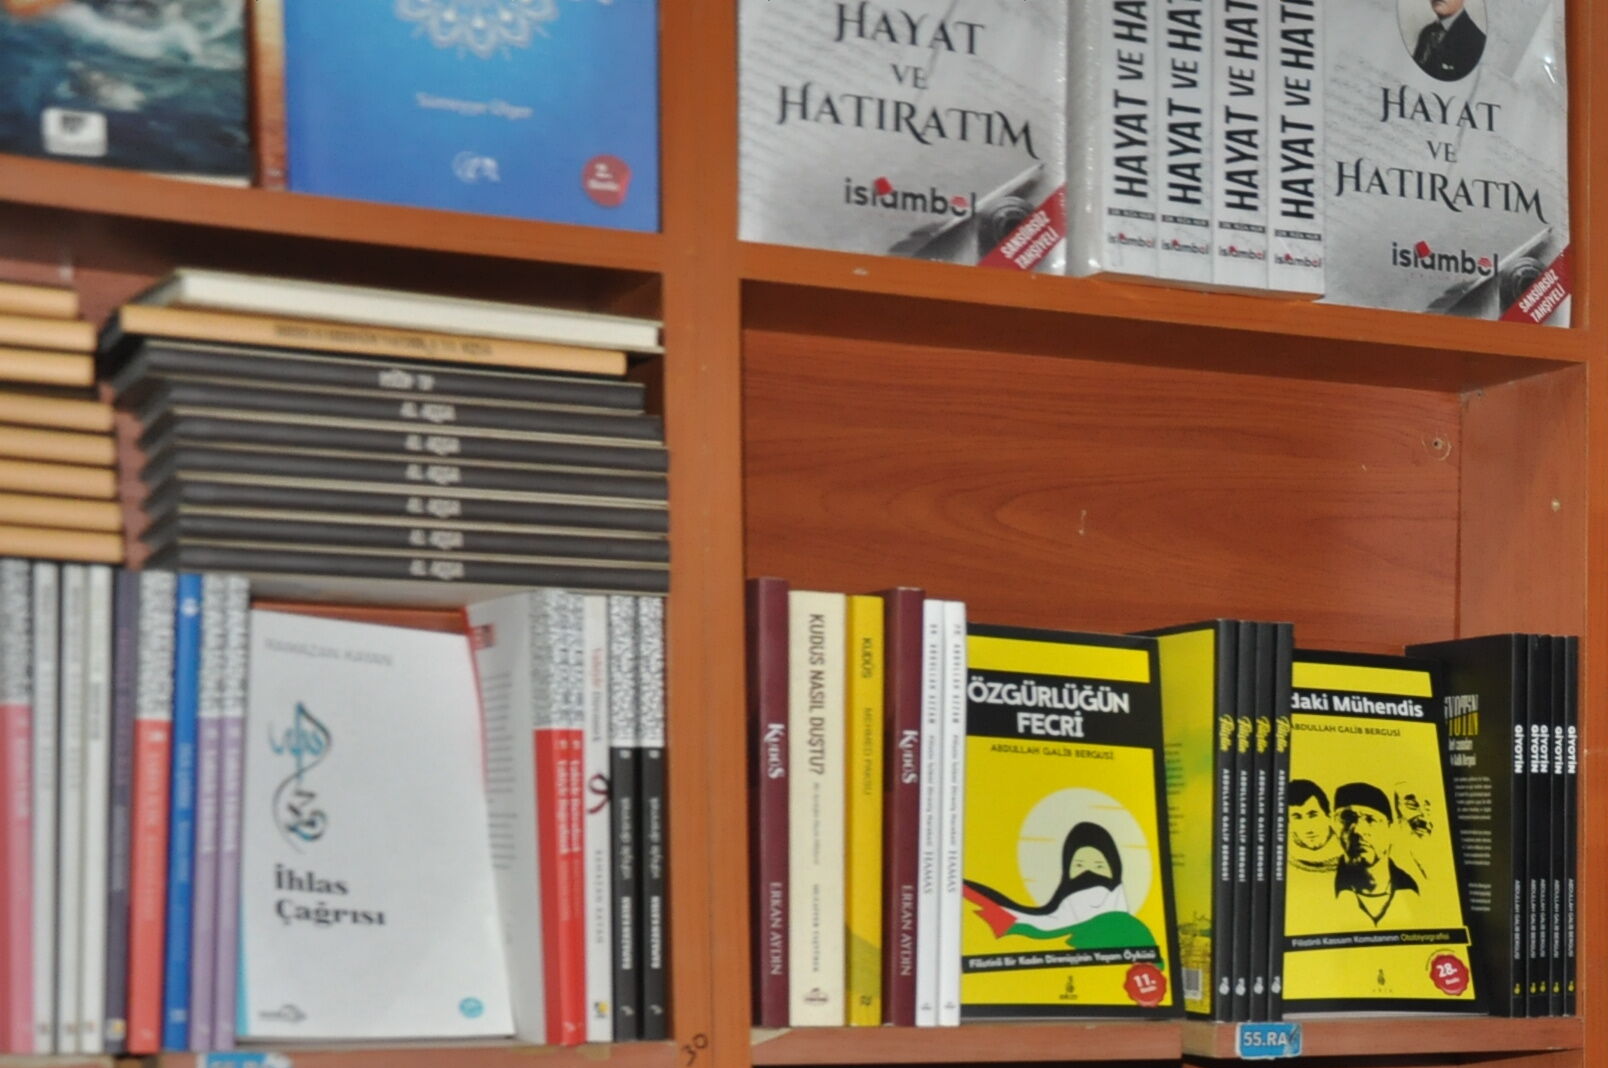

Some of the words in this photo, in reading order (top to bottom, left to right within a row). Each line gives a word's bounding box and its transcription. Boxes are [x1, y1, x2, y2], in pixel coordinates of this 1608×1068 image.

[835, 1, 985, 55] HAYAT
[890, 63, 929, 90] VE
[1117, 49, 1144, 80] VE
[1171, 58, 1198, 89] VE
[1229, 66, 1255, 96] VE
[1285, 76, 1310, 106] VE
[776, 81, 1041, 161] HATIRATIM
[1381, 85, 1501, 131] HAYAT
[1113, 89, 1148, 198] HAYAT
[1167, 98, 1202, 205] HAYAT
[1225, 105, 1258, 212] HAYAT
[1427, 141, 1457, 163] VE
[1281, 115, 1314, 220] HAYAT
[1335, 158, 1549, 224] HATIRATIM
[967, 676, 1130, 713] ÖZGÜRLÜĞÜN
[1333, 695, 1425, 718] Mühendis
[1017, 711, 1085, 738] FECRİ
[991, 744, 1040, 754] ABDULLAH
[274, 863, 349, 895] İhlas
[274, 899, 386, 925] Çağrısı
